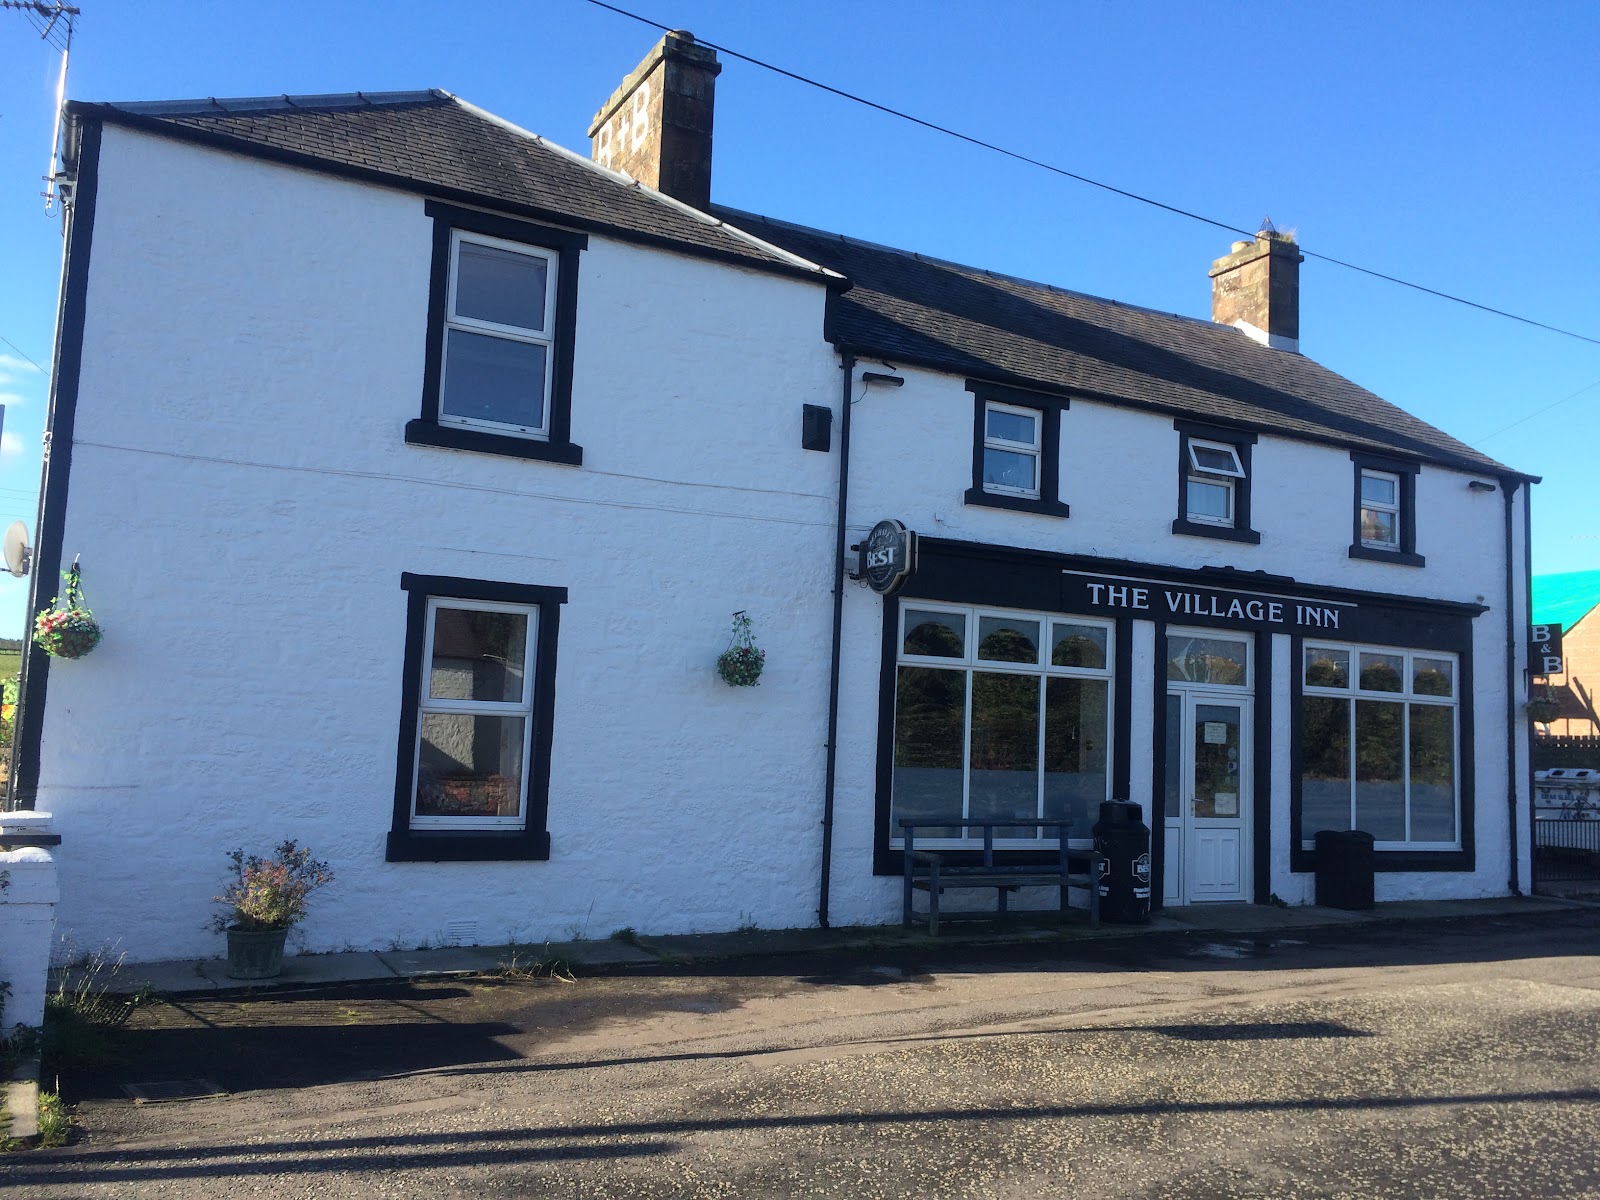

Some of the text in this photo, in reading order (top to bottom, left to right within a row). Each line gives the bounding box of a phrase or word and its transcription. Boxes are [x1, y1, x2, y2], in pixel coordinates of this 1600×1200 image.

[867, 547, 896, 568] BEST
[1086, 583, 1340, 629] THE VILLAGE INN
[1531, 625, 1551, 643] B
[1540, 643, 1552, 654] &
[1543, 656, 1563, 674] B
